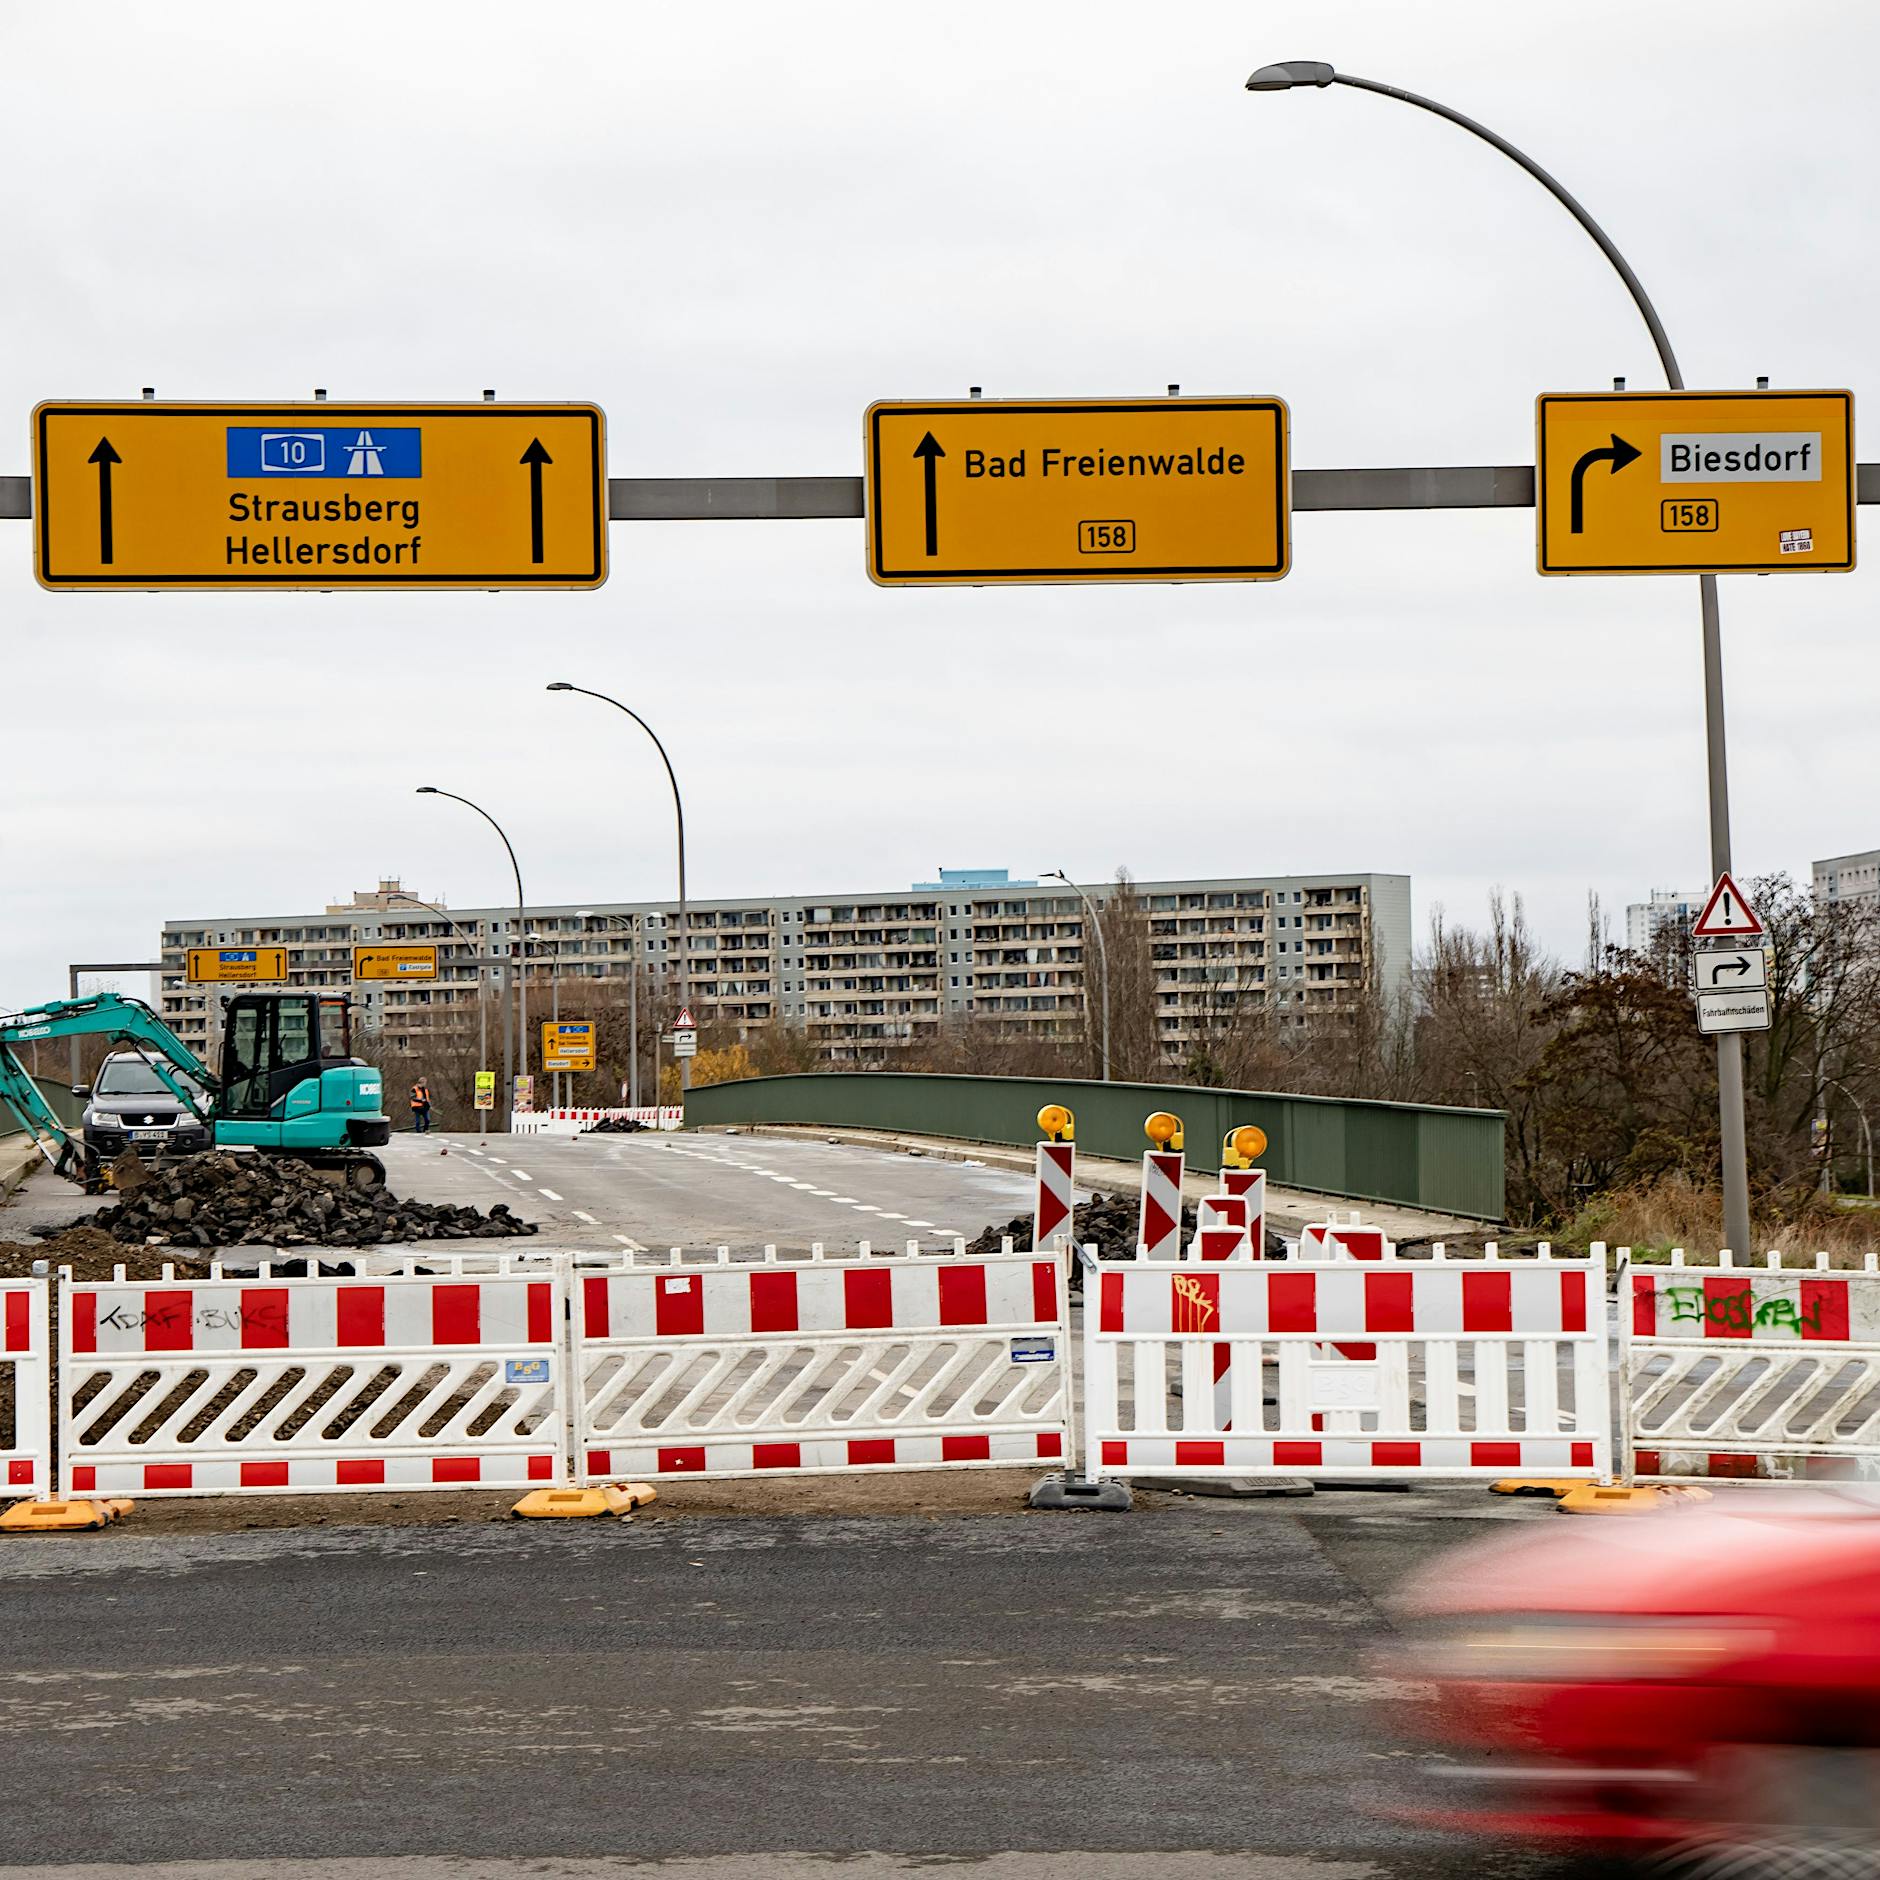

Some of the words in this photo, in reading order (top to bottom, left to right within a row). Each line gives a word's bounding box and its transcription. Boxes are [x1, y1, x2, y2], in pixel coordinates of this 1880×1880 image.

[280, 441, 306, 464] 10
[965, 449, 1026, 478] Bad
[1042, 447, 1246, 477] Freienwalde
[1670, 443, 1812, 473] Biesdorf
[228, 492, 420, 528] Strausberg
[1669, 505, 1709, 527] 158
[225, 535, 422, 565] Hellersdorf
[1086, 526, 1127, 548] 158
